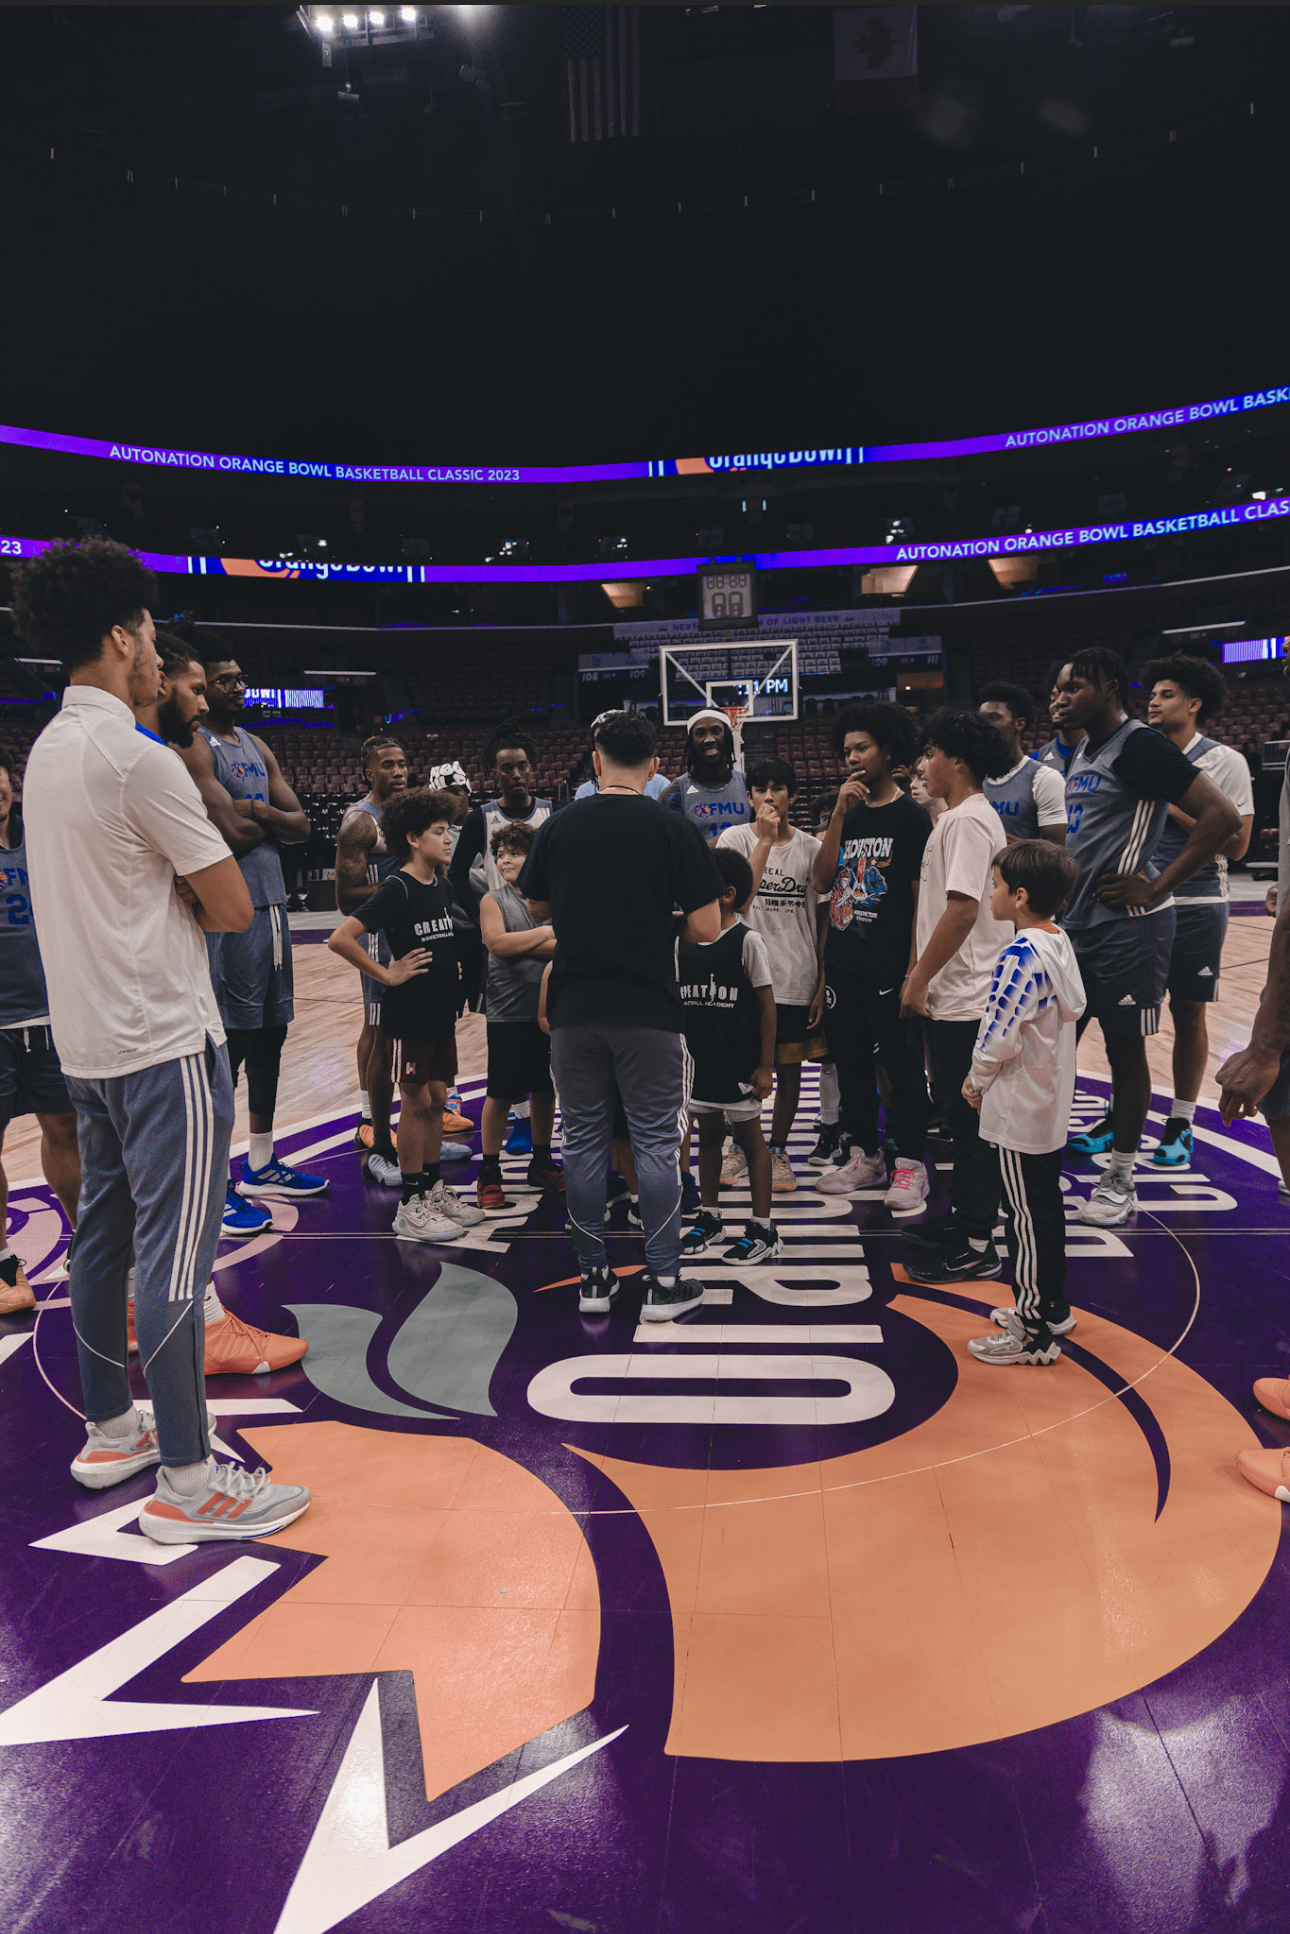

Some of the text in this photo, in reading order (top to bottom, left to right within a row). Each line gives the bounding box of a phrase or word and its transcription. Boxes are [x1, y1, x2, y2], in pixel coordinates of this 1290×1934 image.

[1004, 386, 1290, 447] AUTONATION ORANGE BOWL BASK
[109, 445, 520, 481] AUTONATION ORANGE BOWL BASKETBALL CLASSIC 2023
[896, 539, 1000, 561] AUTONATION
[1004, 531, 1074, 551] ORANGE
[1079, 525, 1129, 543] BOWL
[1133, 509, 1240, 537] BASKETBALL
[672, 622, 698, 631] NEXT
[582, 672, 599, 681] 108
[765, 678, 789, 694] PM
[708, 801, 745, 816] FMU
[989, 800, 1020, 817] MU
